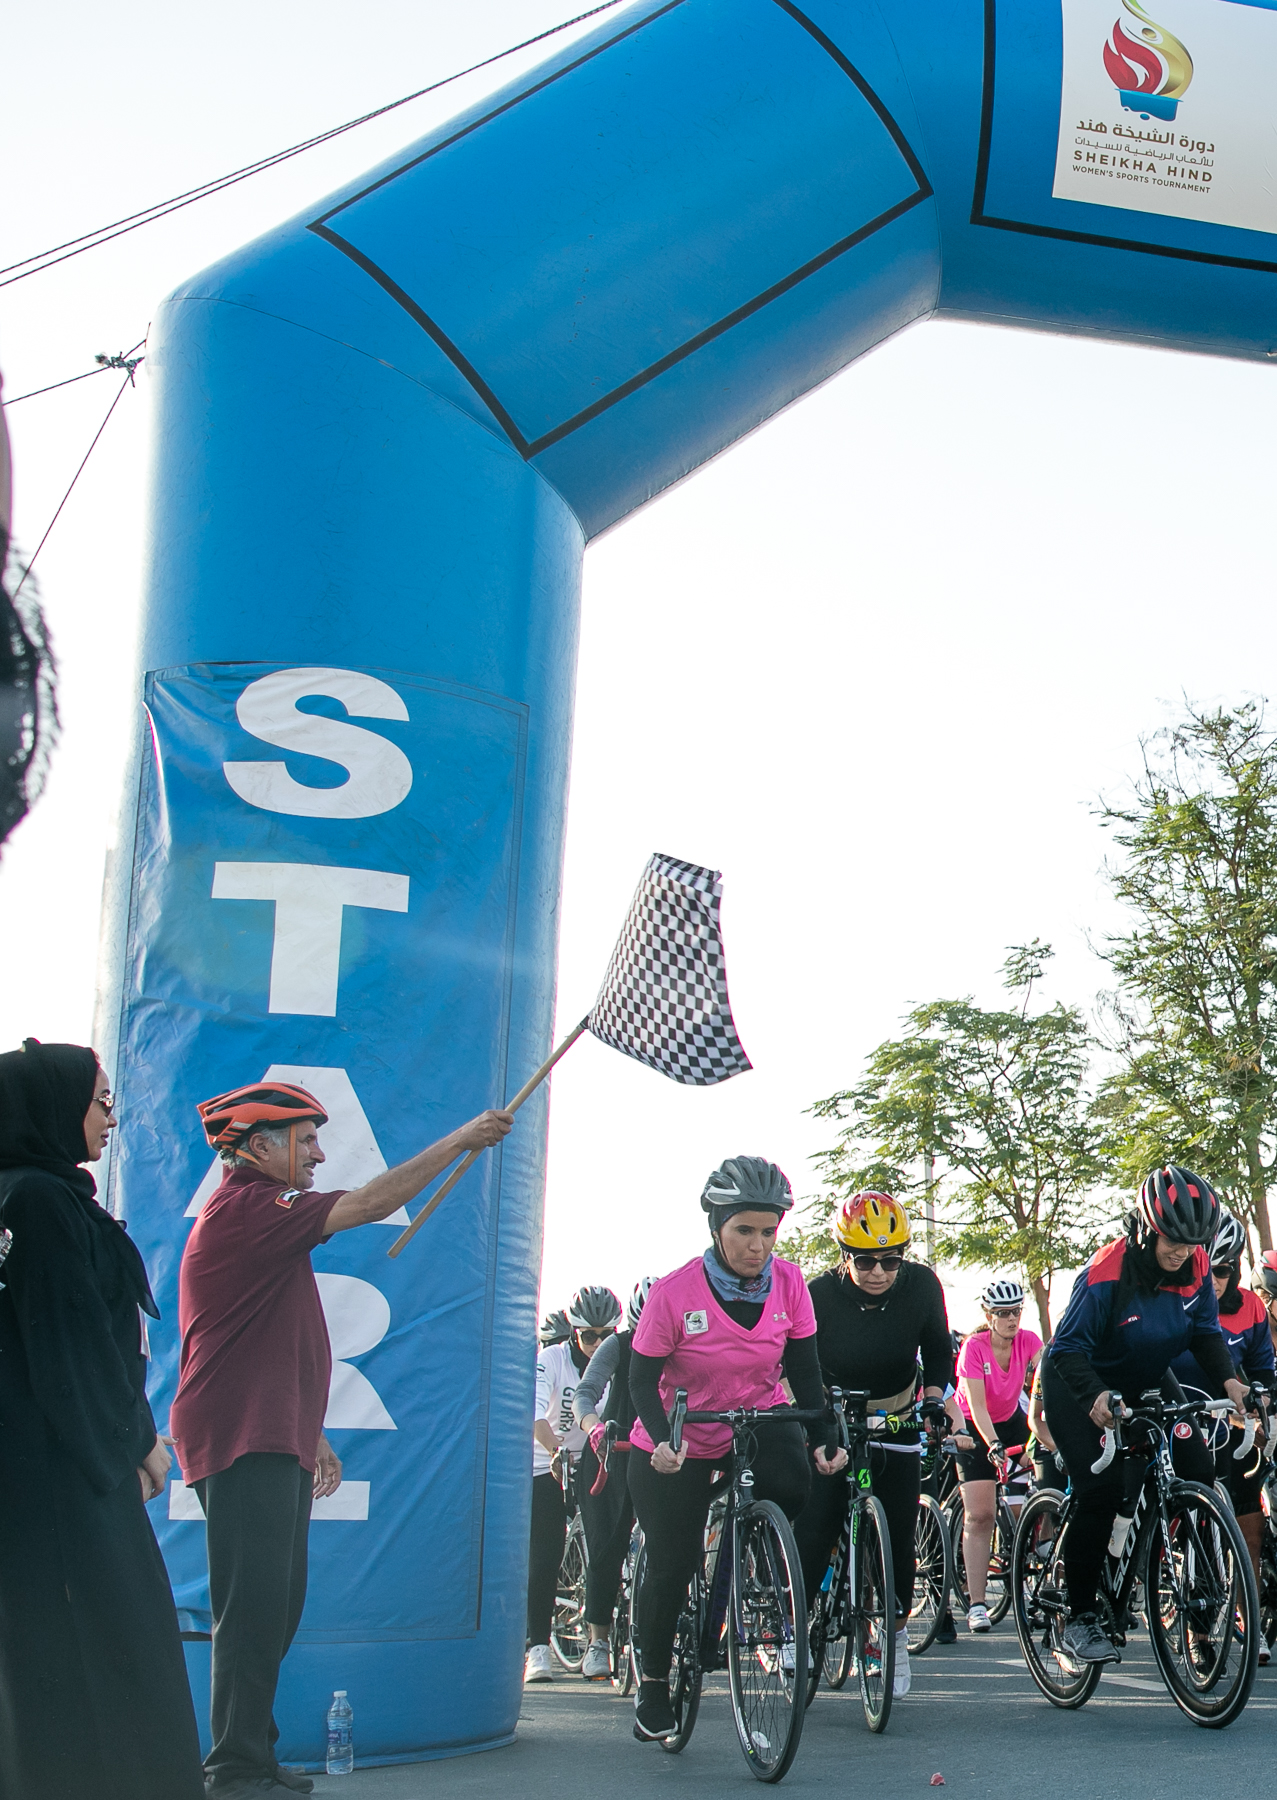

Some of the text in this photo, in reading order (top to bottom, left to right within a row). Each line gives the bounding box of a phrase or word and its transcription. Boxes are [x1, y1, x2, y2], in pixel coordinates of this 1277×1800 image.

[1075, 118, 1215, 154] دورة الشيخة هند
[1072, 164, 1211, 194] WOMEN'S SPORTS TOURNAMENT
[1073, 149, 1213, 182] SHEIKHA HIND
[167, 667, 414, 1522] STA
[1112, 1482, 1148, 1600] SCOTT
